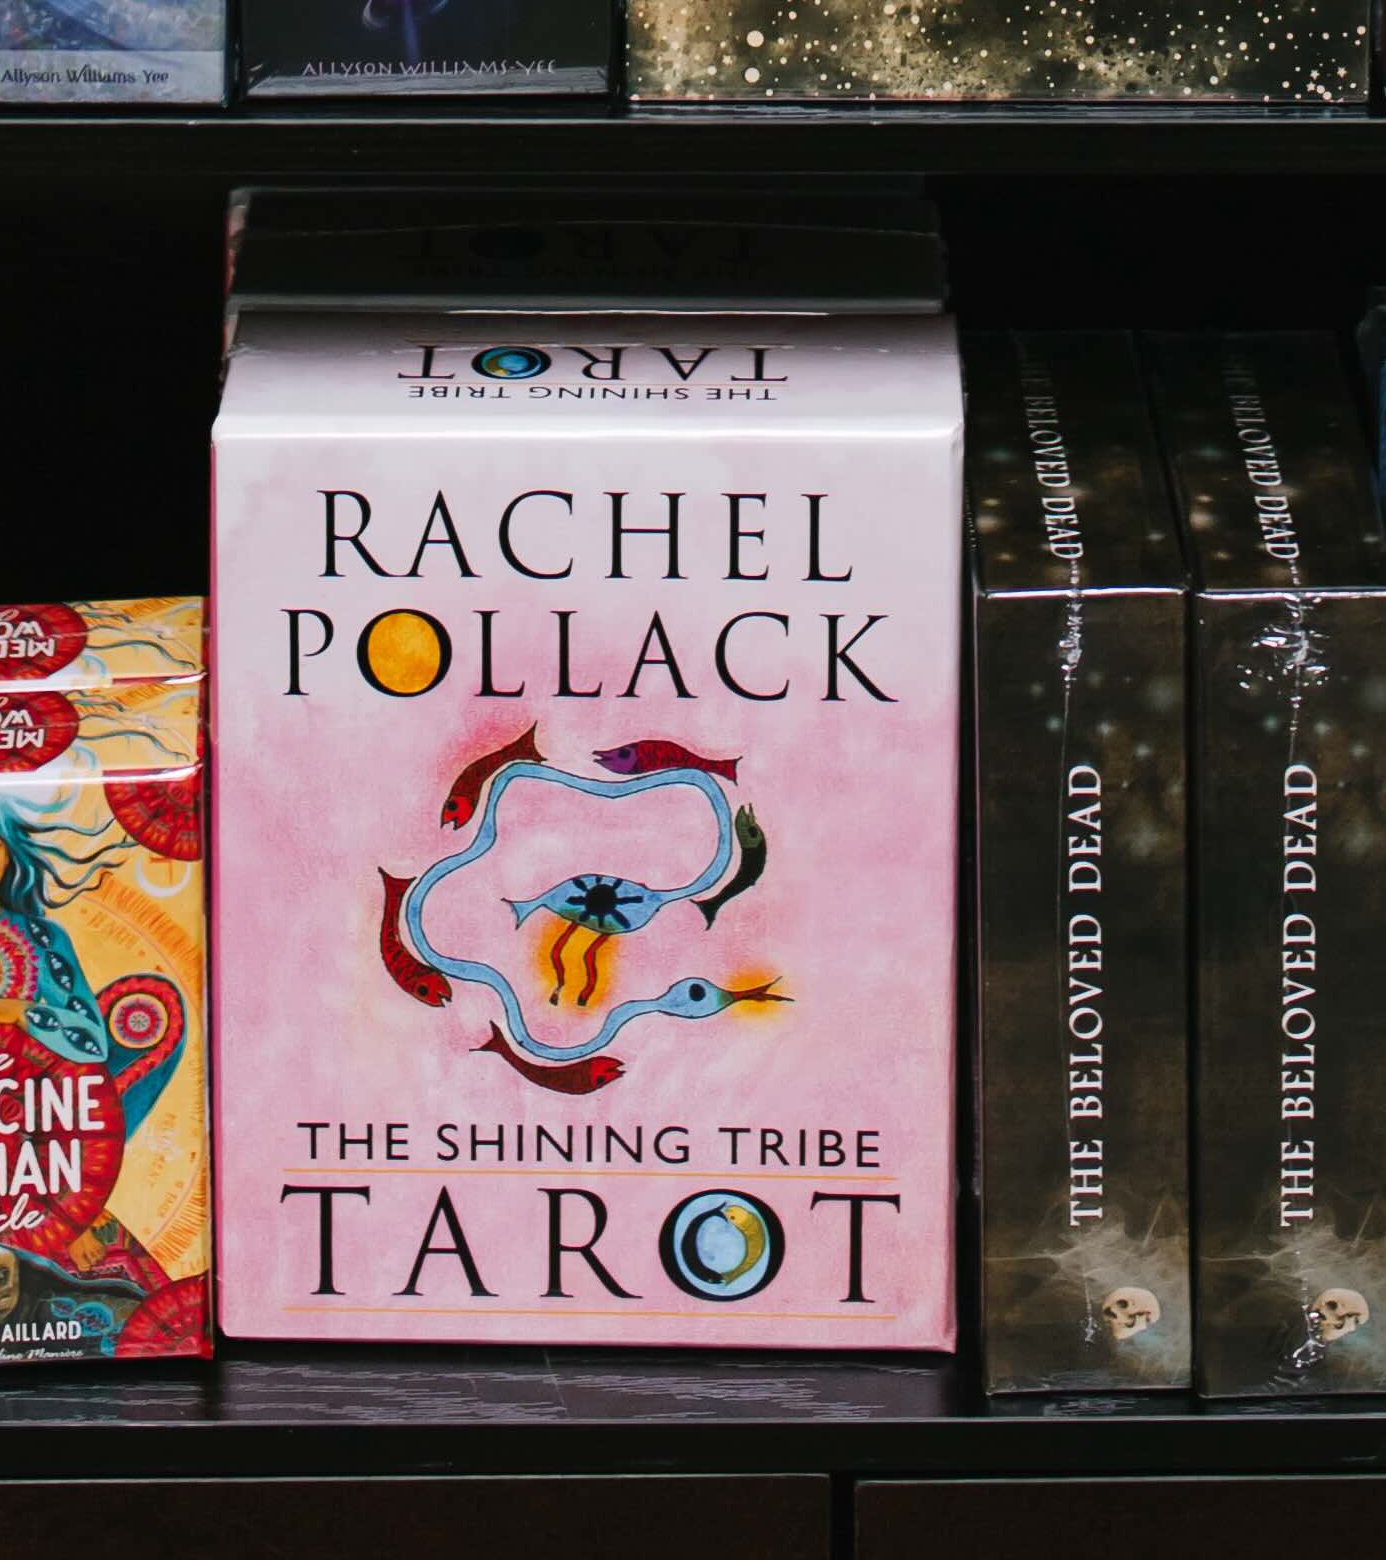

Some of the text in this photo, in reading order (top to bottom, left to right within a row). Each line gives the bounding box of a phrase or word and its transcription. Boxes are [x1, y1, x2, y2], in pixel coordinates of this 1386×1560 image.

[317, 489, 854, 581] RACHEL
[280, 607, 899, 704] POLLACK
[1280, 763, 1318, 1227] THE BELOVED DEAD
[296, 1122, 881, 1168] THE SHINING TRIBE
[280, 1184, 901, 1303] TAROT
